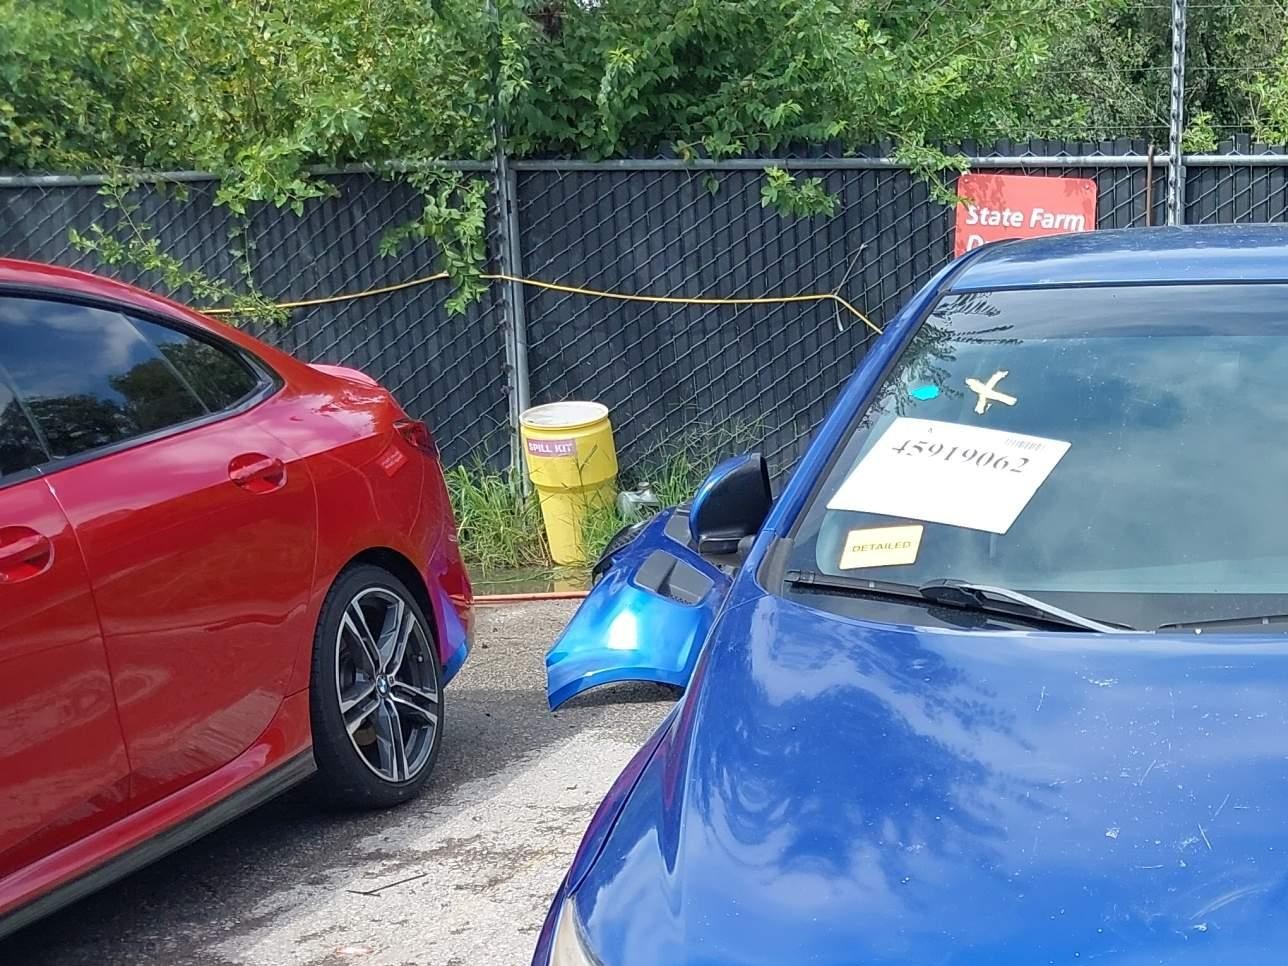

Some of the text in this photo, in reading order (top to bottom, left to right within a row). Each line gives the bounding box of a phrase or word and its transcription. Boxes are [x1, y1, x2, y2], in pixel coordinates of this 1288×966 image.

[965, 206, 1086, 232] State Farm
[528, 442, 573, 453] SPILL KIT
[891, 440, 1030, 473] 45919062
[851, 541, 912, 553] DETAILED
